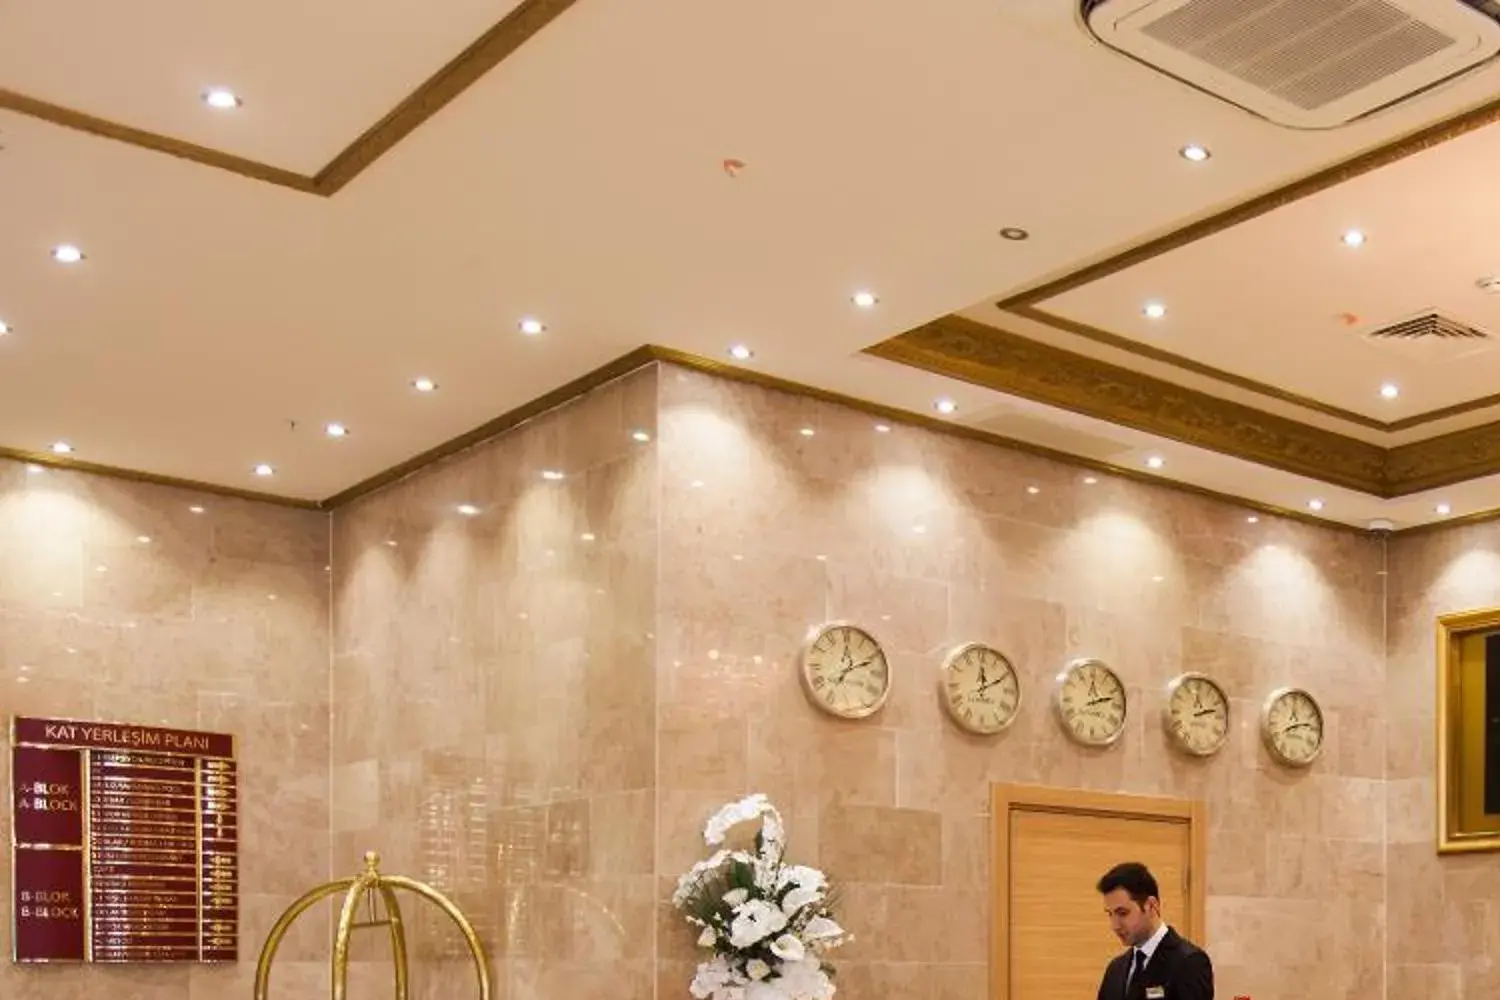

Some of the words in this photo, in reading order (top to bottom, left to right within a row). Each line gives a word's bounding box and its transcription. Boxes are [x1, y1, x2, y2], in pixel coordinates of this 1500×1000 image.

[45, 725, 77, 740] KAT
[81, 727, 161, 746] YERLEŞİM
[165, 733, 209, 749] PLANI
